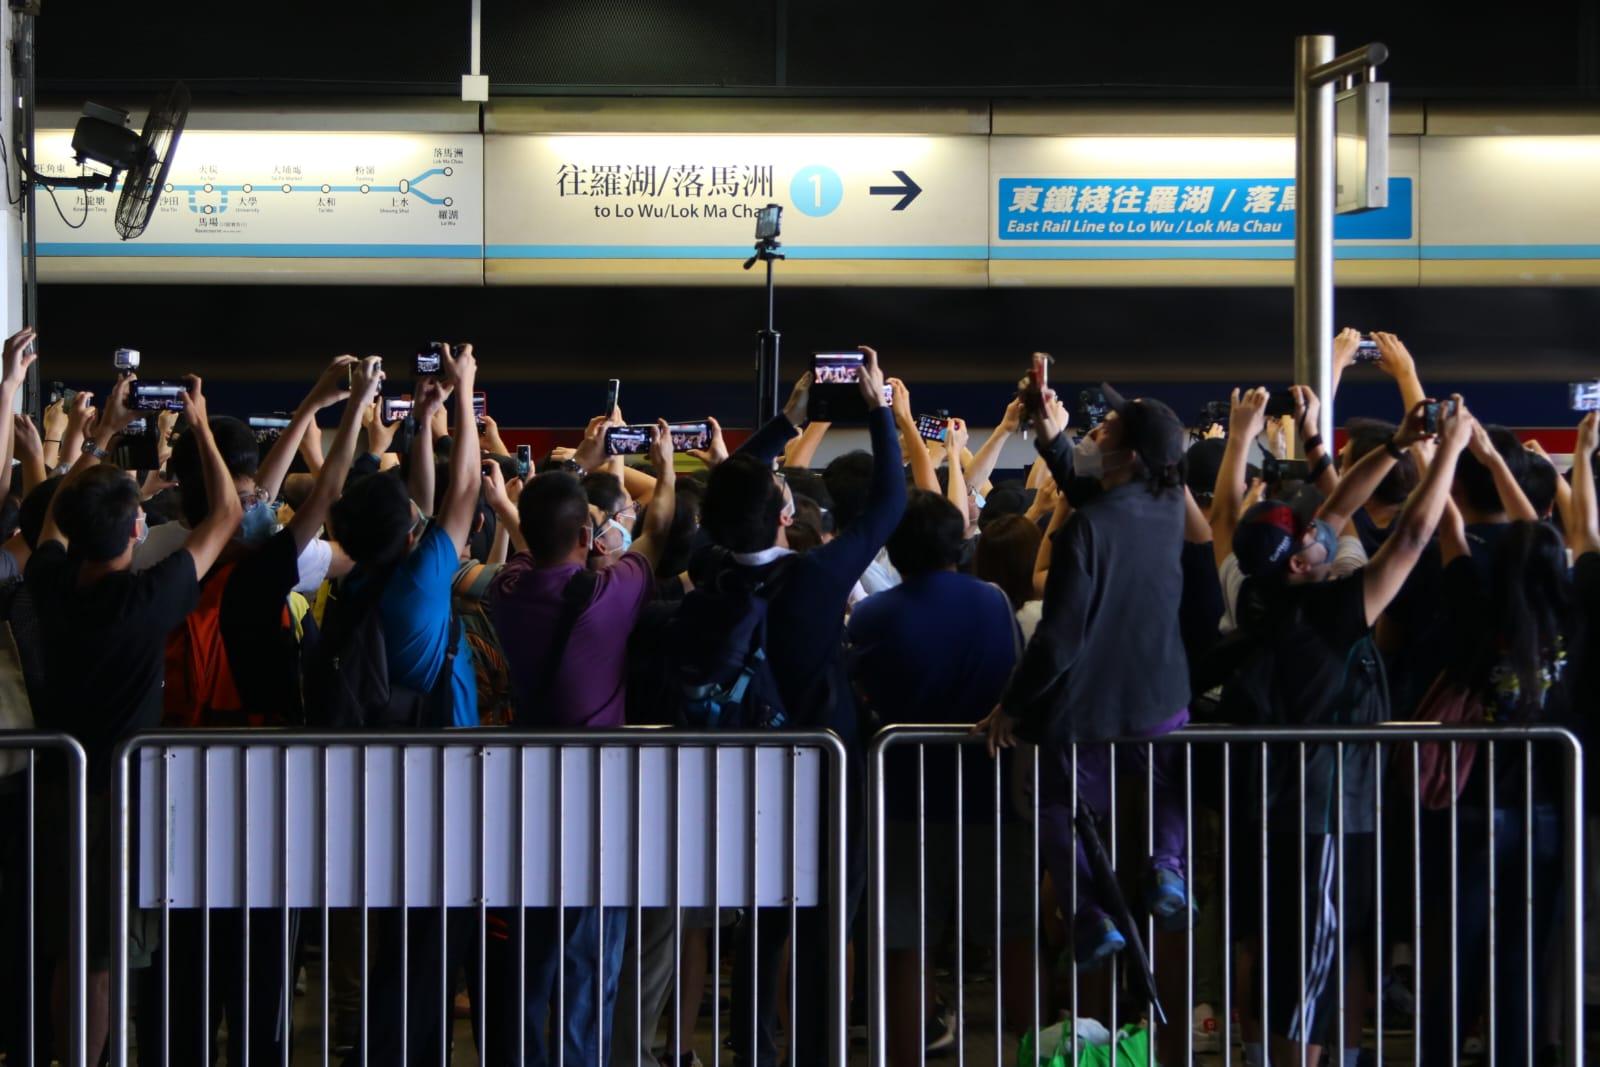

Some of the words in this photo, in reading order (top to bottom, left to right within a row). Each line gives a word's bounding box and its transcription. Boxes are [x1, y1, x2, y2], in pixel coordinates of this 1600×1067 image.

[556, 163, 774, 198] 往羅湖/落馬洲
[809, 173, 823, 208] 1
[594, 205, 611, 218] to
[615, 204, 634, 218] Lo
[638, 204, 699, 219] Wu/Lok
[703, 204, 728, 218] Ma
[732, 203, 761, 218] Cha
[1007, 220, 1039, 233] East
[1041, 219, 1071, 233] Rail
[1072, 219, 1105, 233] Line
[1108, 221, 1124, 233] to
[1127, 220, 1146, 233] Lo
[1150, 220, 1174, 233] Wu
[1185, 219, 1213, 233] Lok
[1215, 220, 1240, 233] Ma
[1243, 219, 1282, 233] Chau
